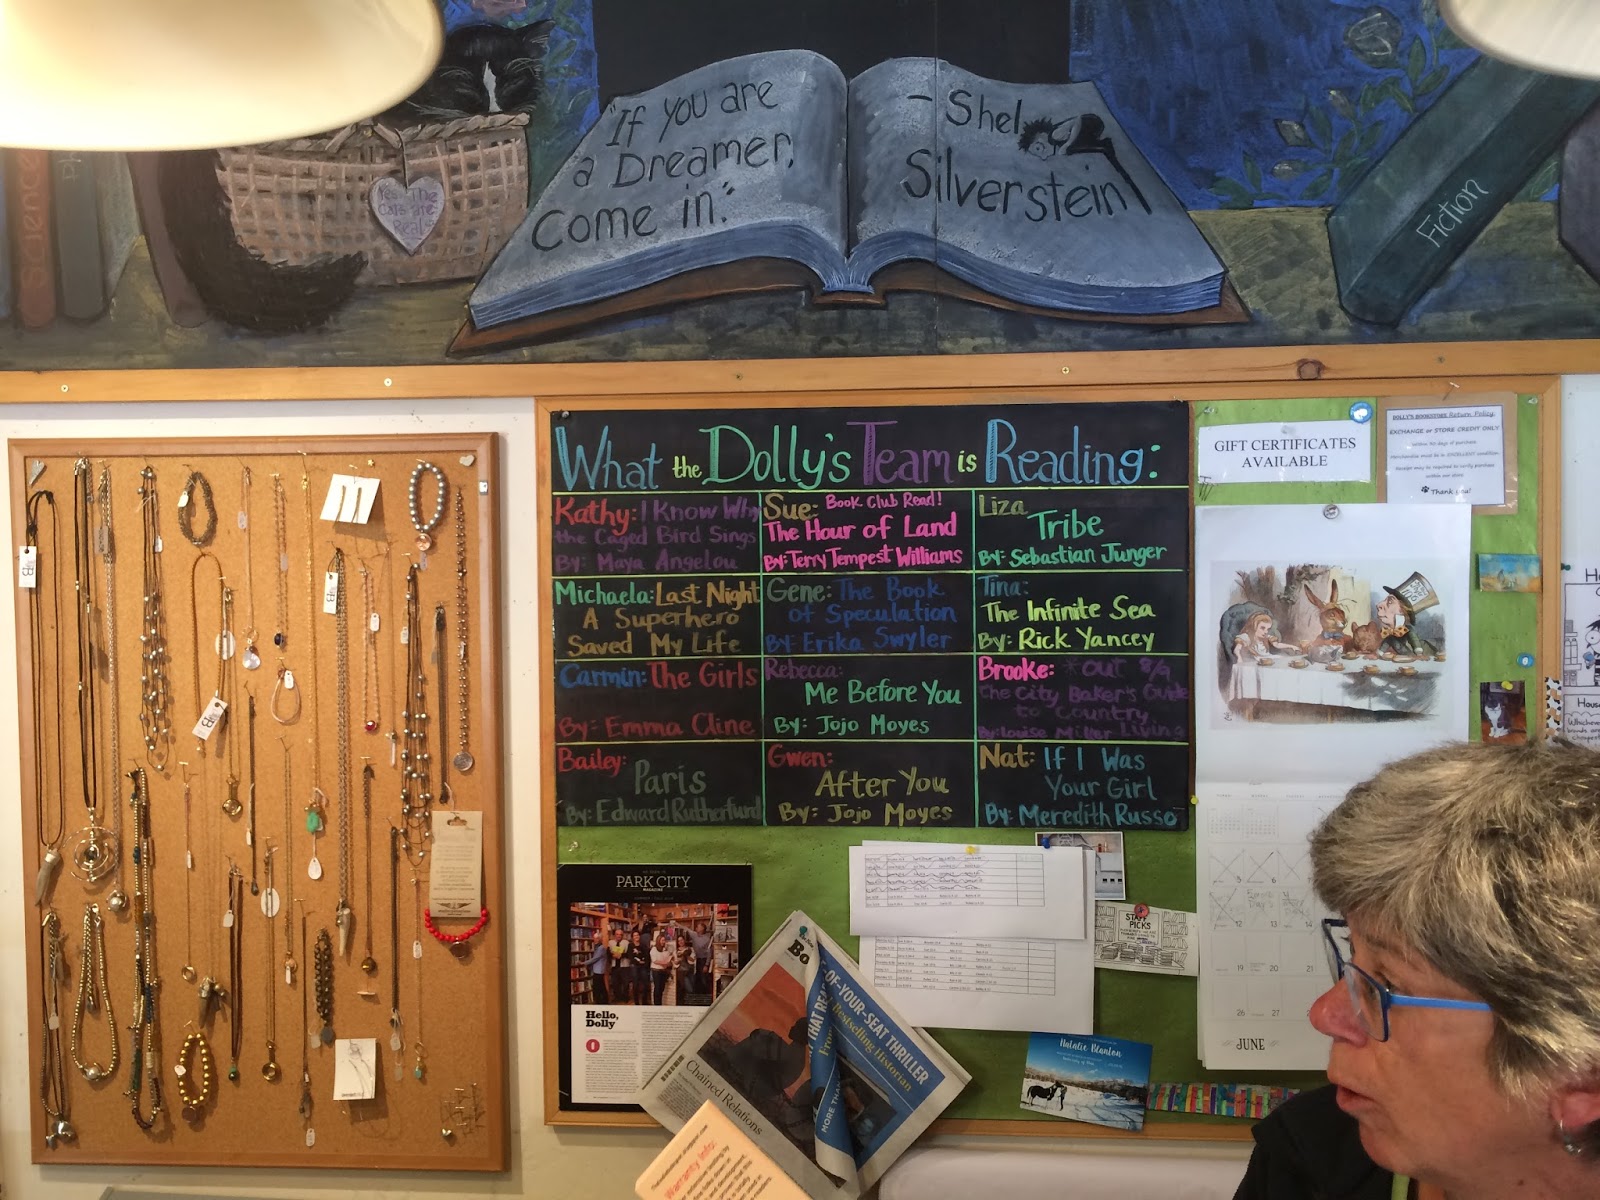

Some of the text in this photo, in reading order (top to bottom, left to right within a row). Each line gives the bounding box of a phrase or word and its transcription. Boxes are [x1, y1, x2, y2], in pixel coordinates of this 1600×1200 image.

[659, 89, 708, 143] you
[721, 80, 778, 112] are
[946, 89, 1022, 134] Shel
[573, 132, 794, 188] a Dreamer,
[902, 146, 1127, 222] Silverstein
[1416, 179, 1489, 248] Fiction
[531, 205, 656, 251] Come
[555, 419, 1161, 490] What the Dolly's Team is Reading:
[1214, 437, 1356, 453] GIFT CERTIFICATES
[1241, 455, 1328, 469] AVAILABLE
[555, 497, 761, 536] Kathy: I Know Why
[763, 491, 942, 520] Sue: Book Club Read!
[978, 494, 1028, 517] Liza
[763, 512, 957, 544] The Hour of Land
[1027, 509, 1104, 540] Tribe
[553, 525, 756, 553] the Caged Bird Sings
[597, 552, 645, 573] Maya
[655, 548, 738, 573] Angelou
[785, 550, 827, 570] Terry
[825, 544, 893, 570] Tempest
[896, 545, 963, 567] Williams
[978, 543, 1167, 567] By: Sebastian Junger
[555, 579, 761, 610] Michaela: Last Night
[766, 576, 945, 602] Gene: The Book
[978, 574, 1029, 597] Tina:
[583, 607, 739, 629] A Superhero
[789, 602, 957, 628] of Speculation
[981, 595, 1156, 623] The Infinite Sea
[567, 630, 741, 657] Saved My Life
[803, 632, 864, 653] Erika
[873, 625, 952, 650] Swyler
[978, 626, 1155, 653] By: Rick Yancey
[560, 661, 758, 690] Carmin: The Girls
[764, 658, 843, 680] Rebecca:
[978, 657, 1054, 681] Brooke:
[805, 678, 961, 705] Me Before You
[558, 712, 755, 741] By: Emma Cline
[773, 714, 930, 735] By: Jojo Moyes
[557, 747, 627, 776] Bailey:
[768, 744, 833, 767] Gwen:
[980, 743, 1146, 771] Nat: If I Was
[634, 759, 707, 794] Paris
[815, 766, 950, 798] After You
[1045, 773, 1157, 801] Your Girl
[565, 805, 592, 826] By:
[596, 797, 670, 822] Edward
[778, 801, 953, 826] By: Jojo Moyes
[984, 801, 1177, 827] By: Meredith Russo
[616, 876, 690, 888] PARK CITY
[1129, 920, 1151, 930] PICKS
[585, 1010, 619, 1020] Hello,
[585, 1019, 616, 1029] Dolly
[808, 1012, 823, 1041] THAT
[832, 1001, 913, 1092] Bestselling Historian
[1060, 1038, 1089, 1052] Natalie
[1091, 1043, 1123, 1058] Blanton
[1236, 1037, 1265, 1051] JUNE
[885, 1034, 929, 1086] THRILLER
[685, 1058, 725, 1097] Chained
[722, 1092, 763, 1136] Relations
[821, 1107, 836, 1133] MORE
[663, 1160, 700, 1199] Warranty
